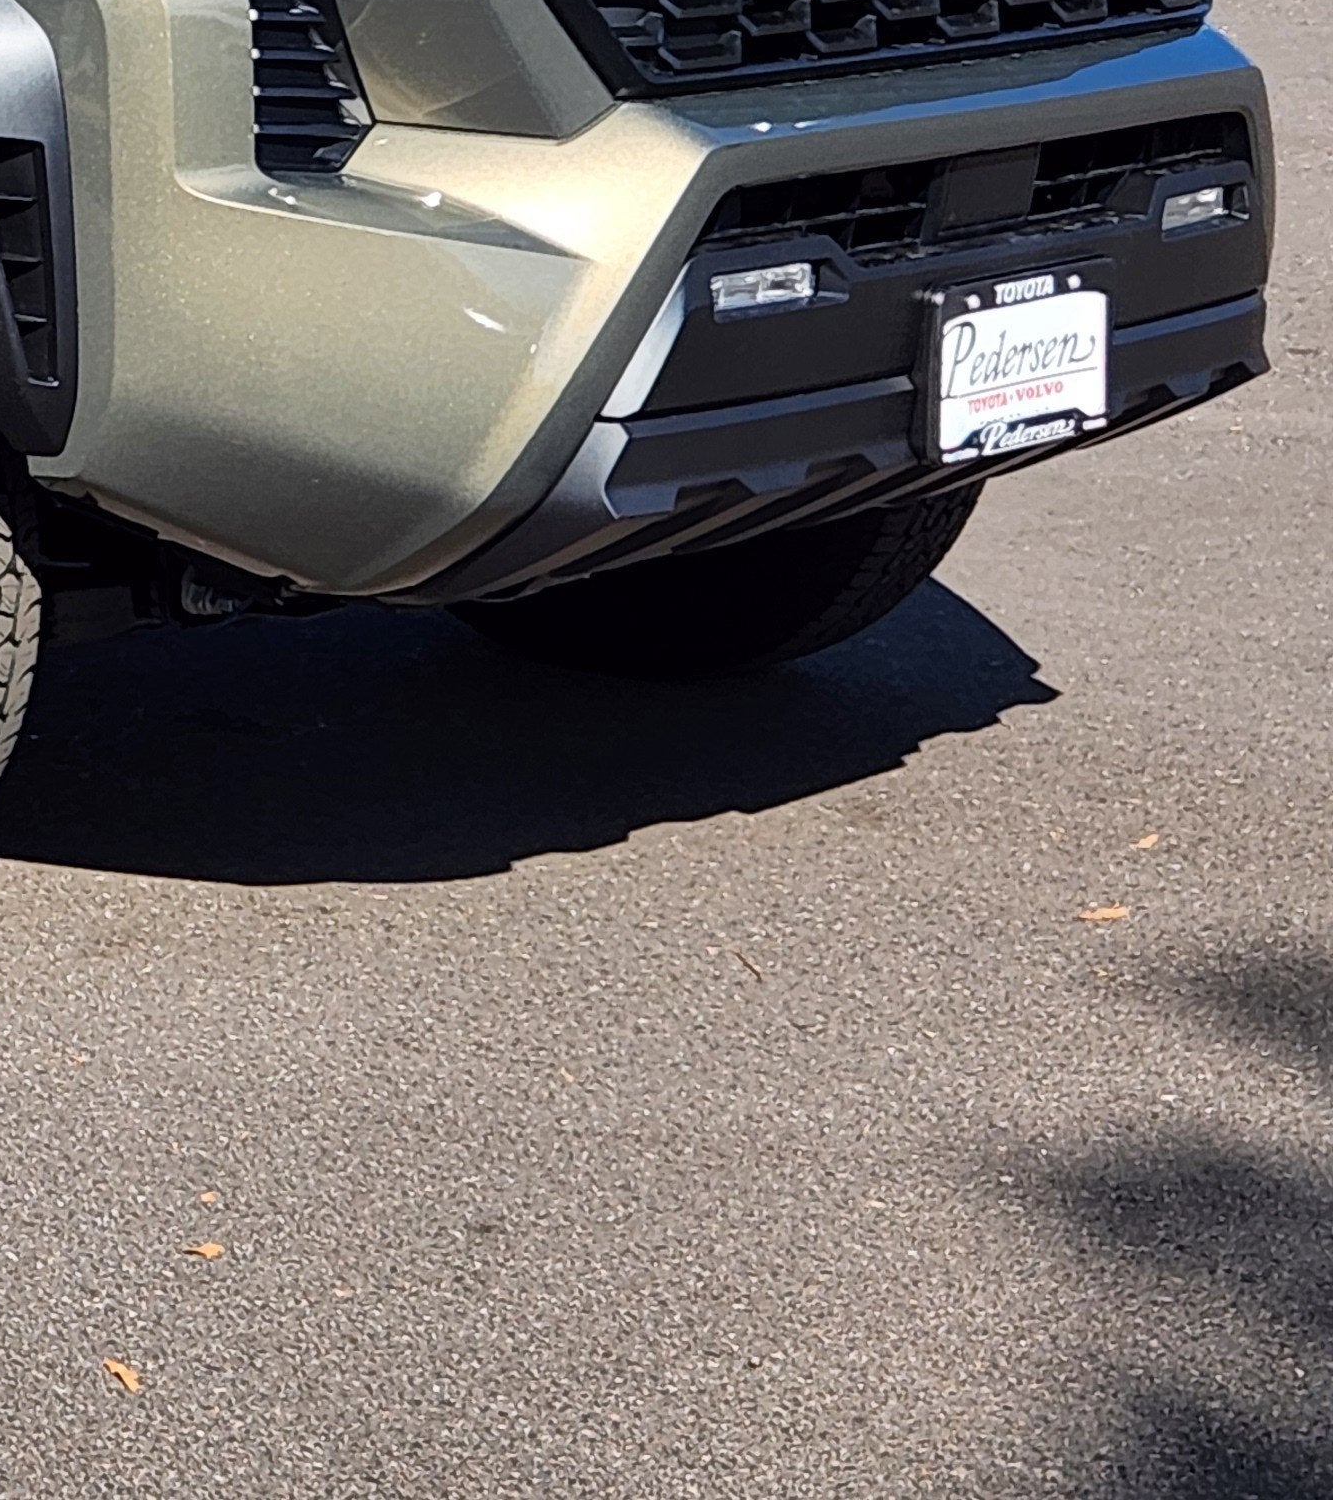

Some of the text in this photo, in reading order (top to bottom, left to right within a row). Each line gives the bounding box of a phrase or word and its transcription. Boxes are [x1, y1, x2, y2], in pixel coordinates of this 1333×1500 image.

[993, 273, 1055, 305] TOYOTA
[941, 320, 1097, 400] Pedersen
[967, 380, 1065, 415] TOYOTA VOLVO
[979, 420, 1076, 455] Pedersen
